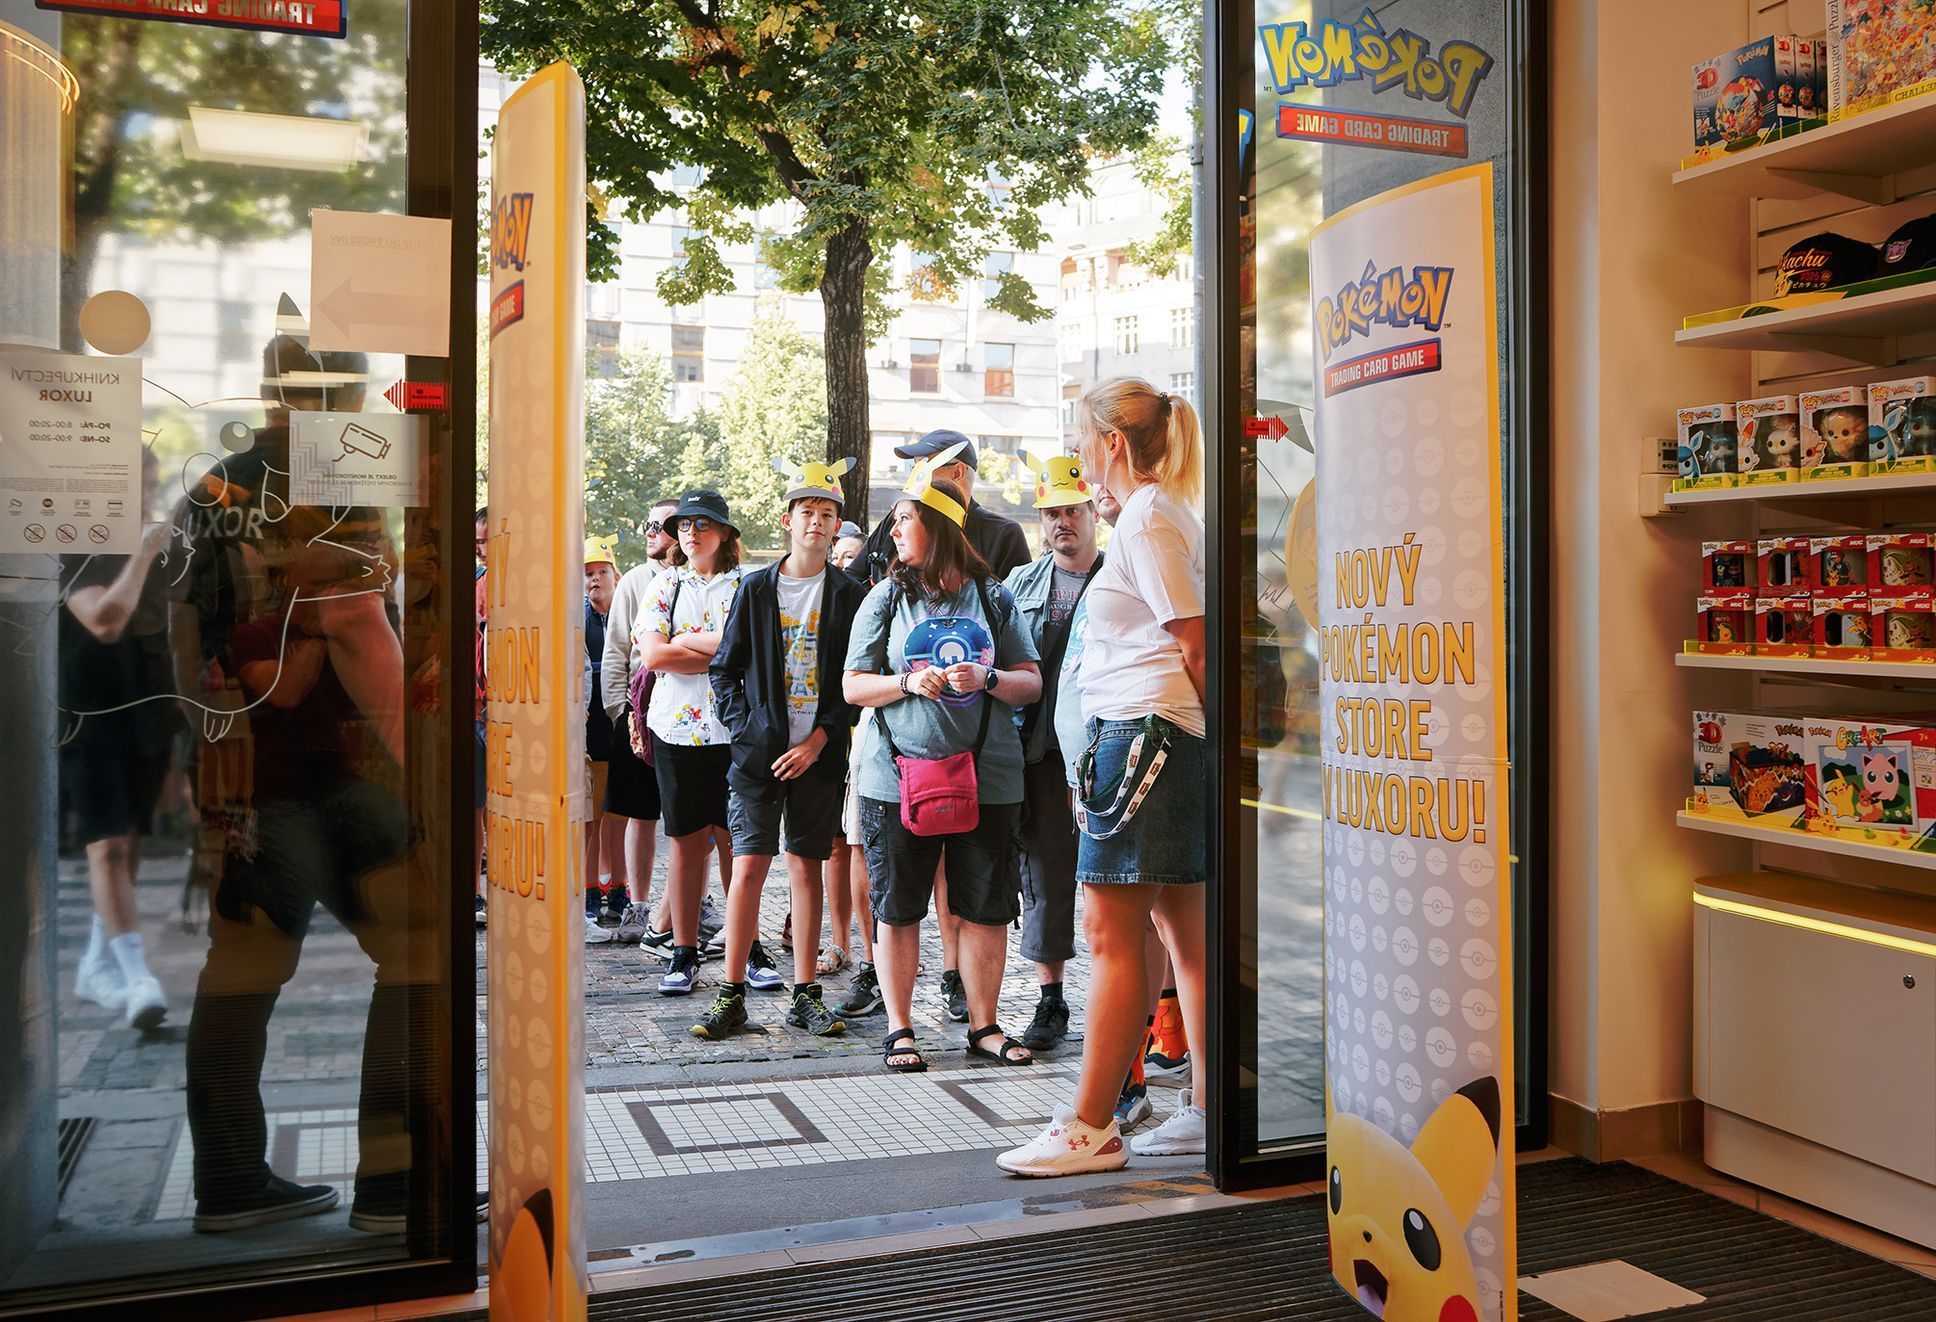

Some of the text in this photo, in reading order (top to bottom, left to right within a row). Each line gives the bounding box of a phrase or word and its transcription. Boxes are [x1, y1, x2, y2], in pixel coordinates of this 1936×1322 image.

[1696, 68, 1719, 91] 3D
[1696, 87, 1720, 101] Puzzle
[1830, 44, 1842, 122] Ravensburger
[1330, 349, 1424, 388] TRADING CARD GAME
[1335, 531, 1423, 610] NOVÝ
[1322, 612, 1476, 685] POKÉMON
[1335, 698, 1433, 762] STORE
[1698, 721, 1723, 744] 3D
[1698, 742, 1724, 754] Puzzle
[1918, 733, 1929, 742] 7+
[1322, 762, 1488, 844] V LUXORU!
